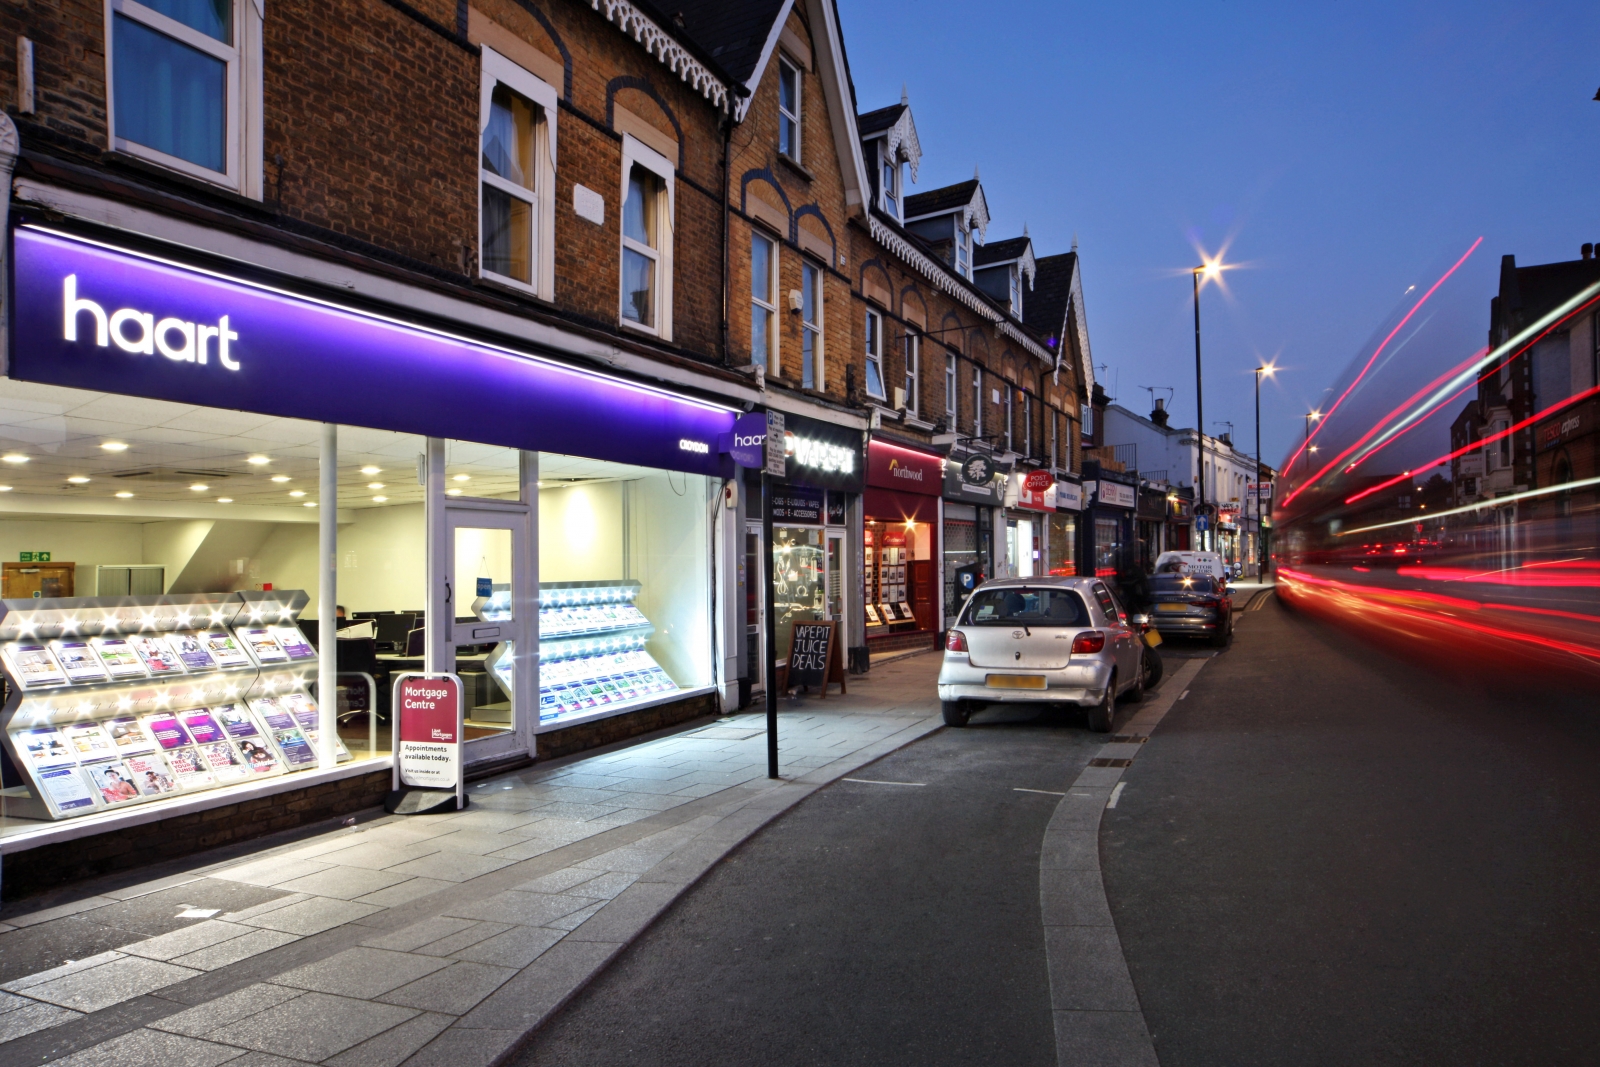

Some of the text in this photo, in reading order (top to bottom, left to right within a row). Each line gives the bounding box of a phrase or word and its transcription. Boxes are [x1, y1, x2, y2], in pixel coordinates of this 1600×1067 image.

[64, 273, 240, 371] haart
[1561, 415, 1580, 437] express
[734, 432, 767, 447] haar
[894, 466, 922, 481] northwood
[787, 497, 806, 507] E-LIQUIDS
[809, 501, 820, 509] VAPES
[794, 640, 827, 654] JUICE
[792, 654, 826, 670] DEALS
[405, 686, 448, 699] Mortgage
[405, 699, 435, 709] Centre
